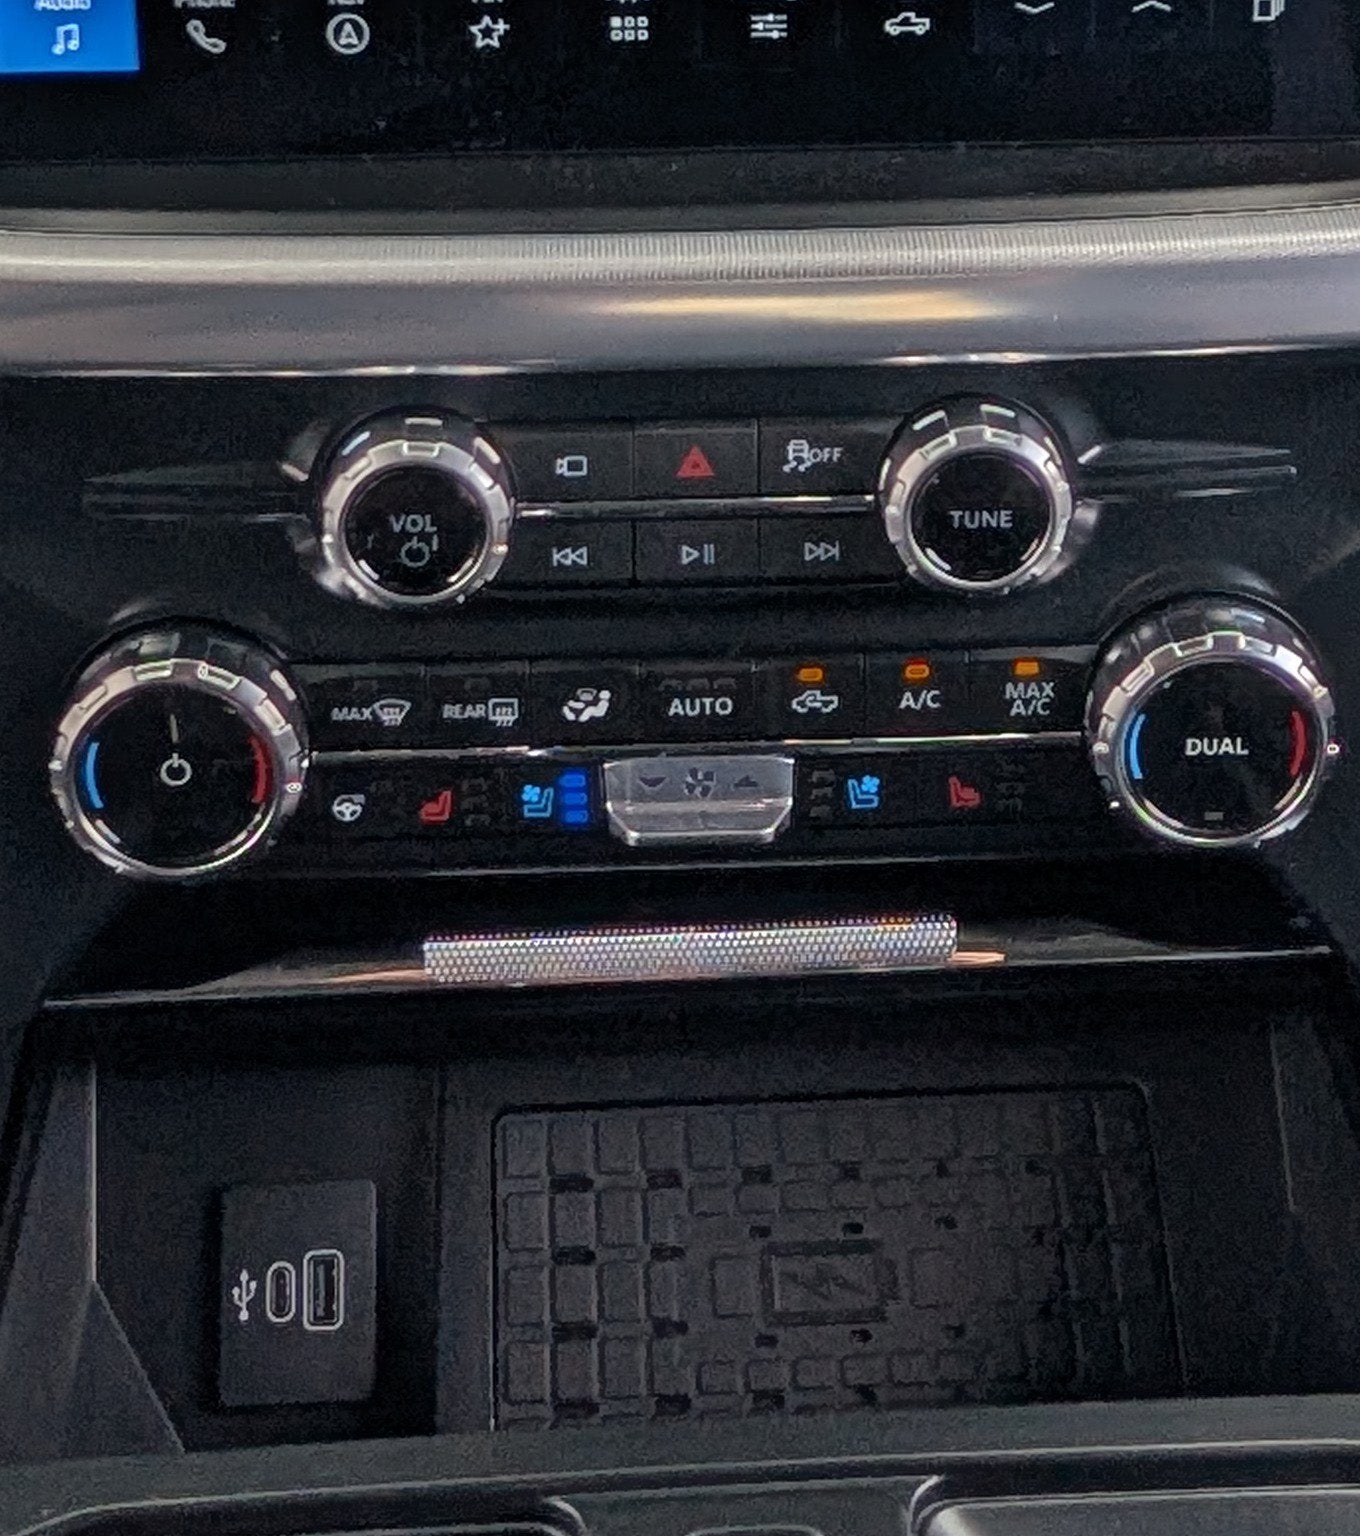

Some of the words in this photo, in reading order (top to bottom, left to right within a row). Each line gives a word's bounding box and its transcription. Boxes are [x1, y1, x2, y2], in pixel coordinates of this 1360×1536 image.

[809, 446, 842, 463] OFF
[388, 513, 438, 534] VOL
[949, 510, 1014, 530] TUNE
[1005, 681, 1056, 699] MAX
[668, 697, 734, 717] AUTO
[898, 689, 942, 711] A/C
[1009, 697, 1051, 716] A/C
[331, 706, 373, 722] MAX
[442, 703, 486, 720] REAR
[1184, 737, 1249, 757] DUAL
